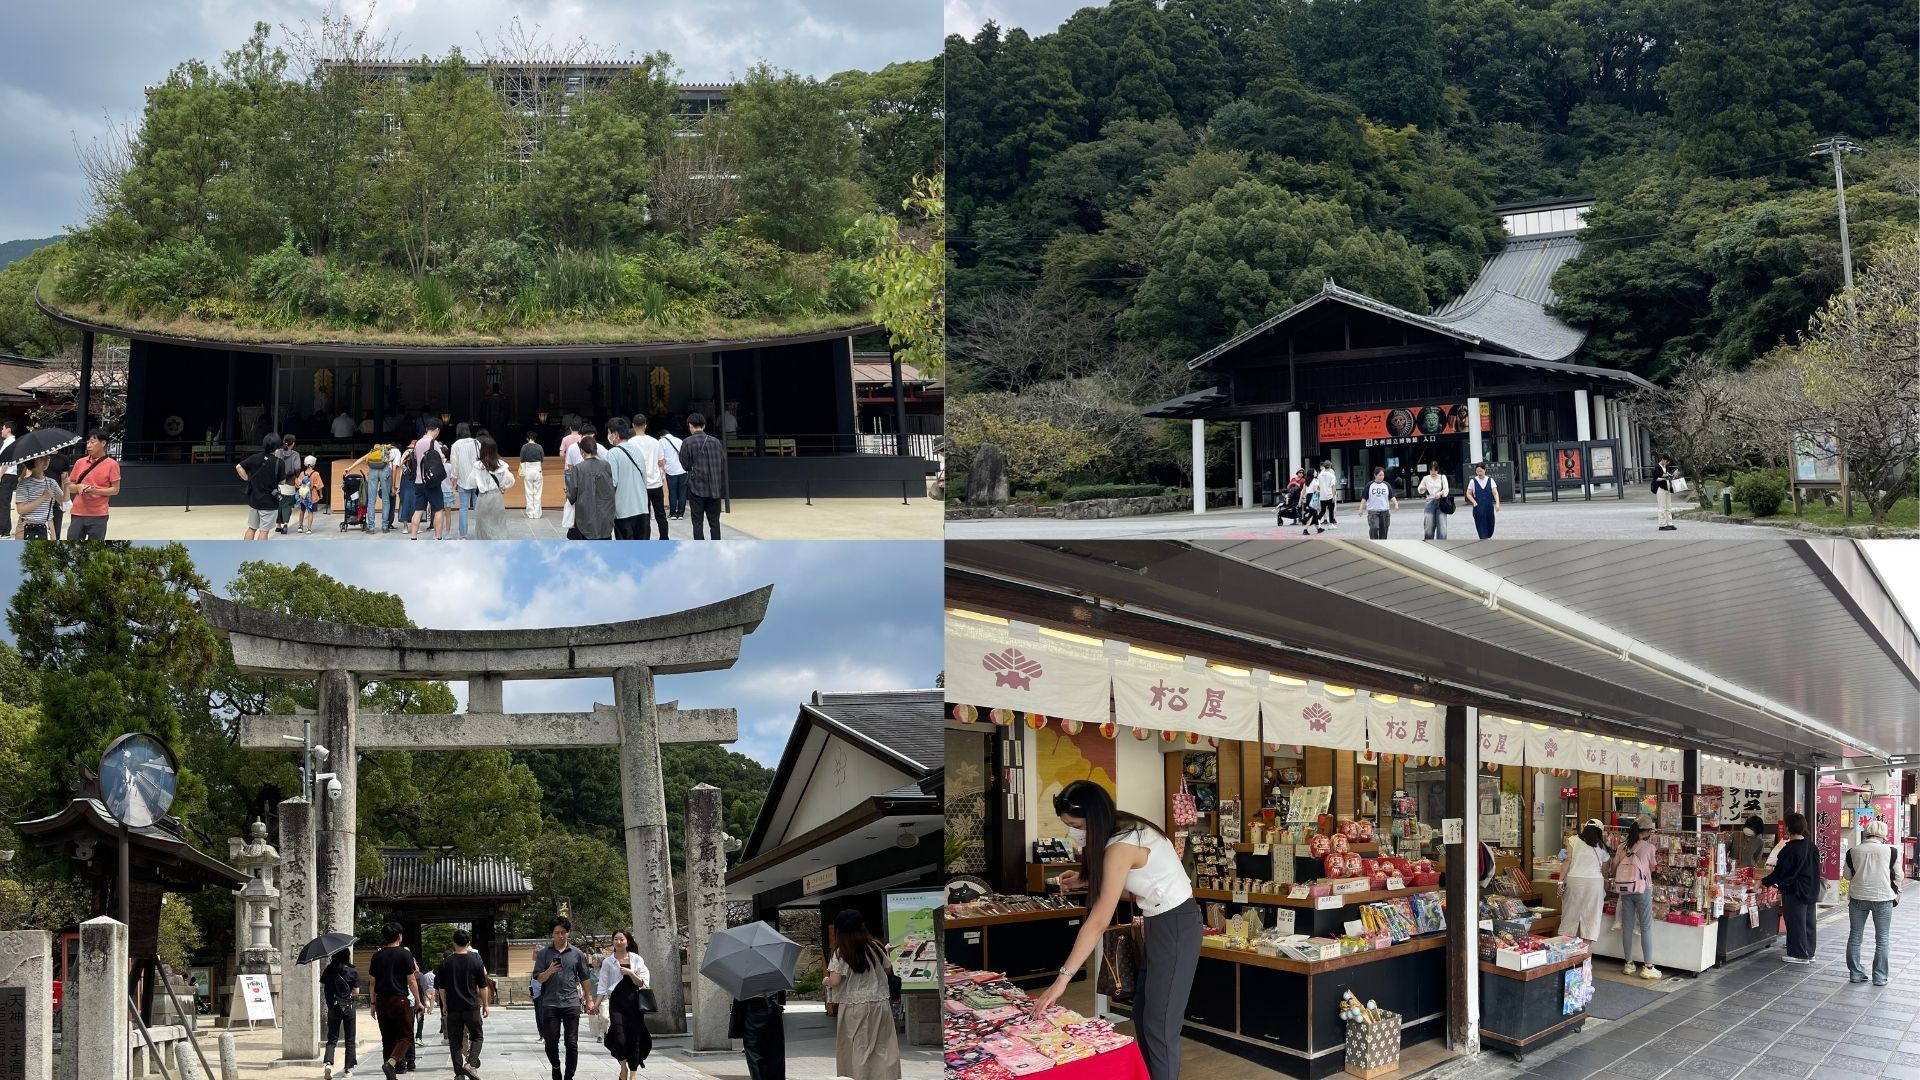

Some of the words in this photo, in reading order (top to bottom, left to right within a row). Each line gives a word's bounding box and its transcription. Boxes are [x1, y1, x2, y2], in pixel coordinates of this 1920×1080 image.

[1323, 414, 1382, 430] 古代メキシコ
[1423, 435, 1436, 443] 入口
[1150, 679, 1227, 720] 松屋
[1386, 716, 1429, 744] 松屋
[1586, 746, 1607, 765] 松屋
[1728, 787, 1741, 821] ラーメン
[643, 839, 666, 937] 明治二十八年
